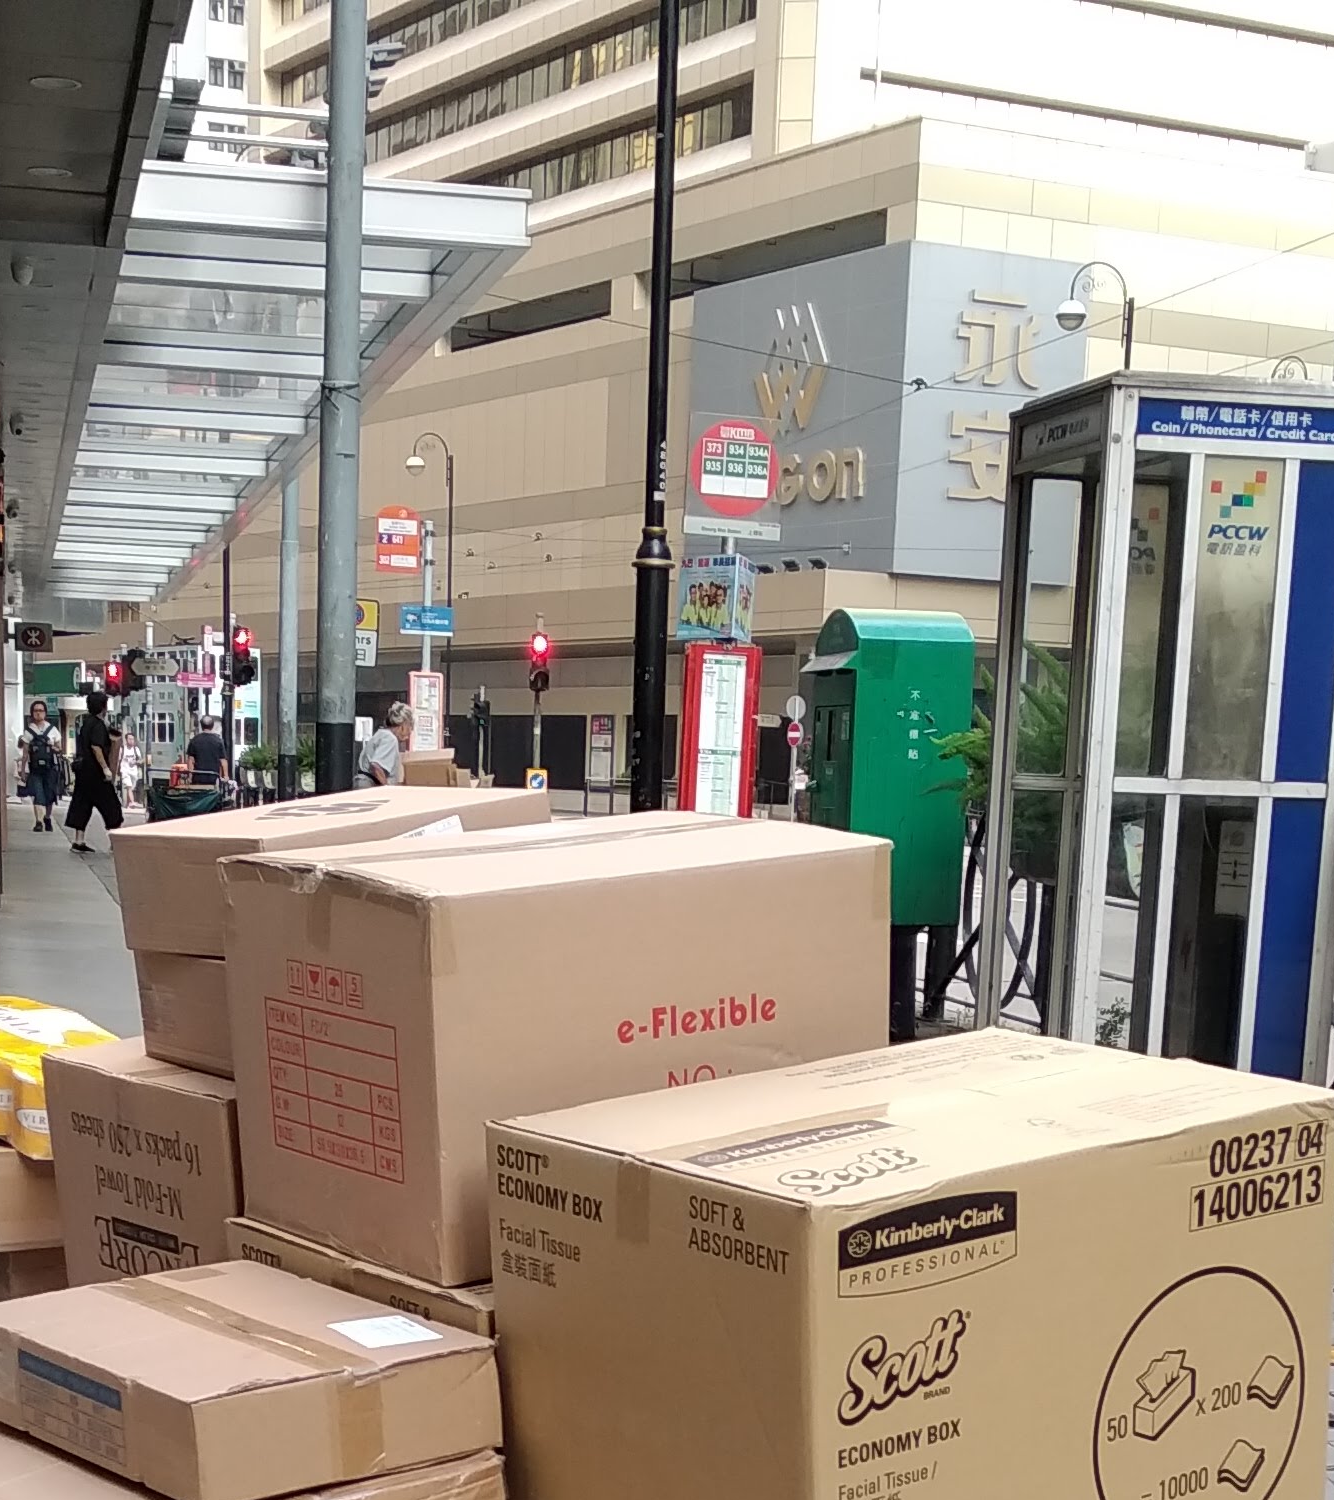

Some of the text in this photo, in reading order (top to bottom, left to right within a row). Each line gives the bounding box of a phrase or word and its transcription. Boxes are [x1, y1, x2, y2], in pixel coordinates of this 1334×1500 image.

[706, 442, 769, 458] 373 934 934A
[1151, 420, 1181, 434] Coin
[1190, 423, 1257, 438] Phonecard
[1266, 428, 1306, 441] Credit
[705, 461, 721, 472] 935
[727, 463, 743, 474] 936
[1208, 524, 1269, 541] PCCW
[617, 993, 776, 1044] e-Flexible
[71, 1111, 104, 1148] sheets
[109, 1121, 132, 1158] 250
[145, 1130, 182, 1167] packs
[379, 1125, 396, 1142] KGS
[726, 1120, 874, 1158] Kimberly-Clark
[1209, 1122, 1324, 1178] 00237 04
[185, 1141, 202, 1176] 16
[777, 1146, 919, 1197] Scott
[94, 1164, 185, 1221] M-Fold Towel
[497, 1172, 603, 1223] ECONOMY BOX
[689, 1194, 746, 1233] SOFT &
[1193, 1165, 1322, 1228] 14006213
[499, 1217, 581, 1263] Facial Tissue
[874, 1202, 1005, 1249] Kimberly-Clark
[688, 1227, 790, 1276] ABSORBENT
[849, 1241, 1001, 1289] PROFESSIONAL
[837, 1308, 967, 1427] Scott
[923, 1385, 951, 1400] BRAND
[1107, 1414, 1128, 1442] 50
[1211, 1381, 1242, 1412] 200
[837, 1417, 962, 1470] ECONOMY BOX
[884, 1465, 929, 1489] Tissue
